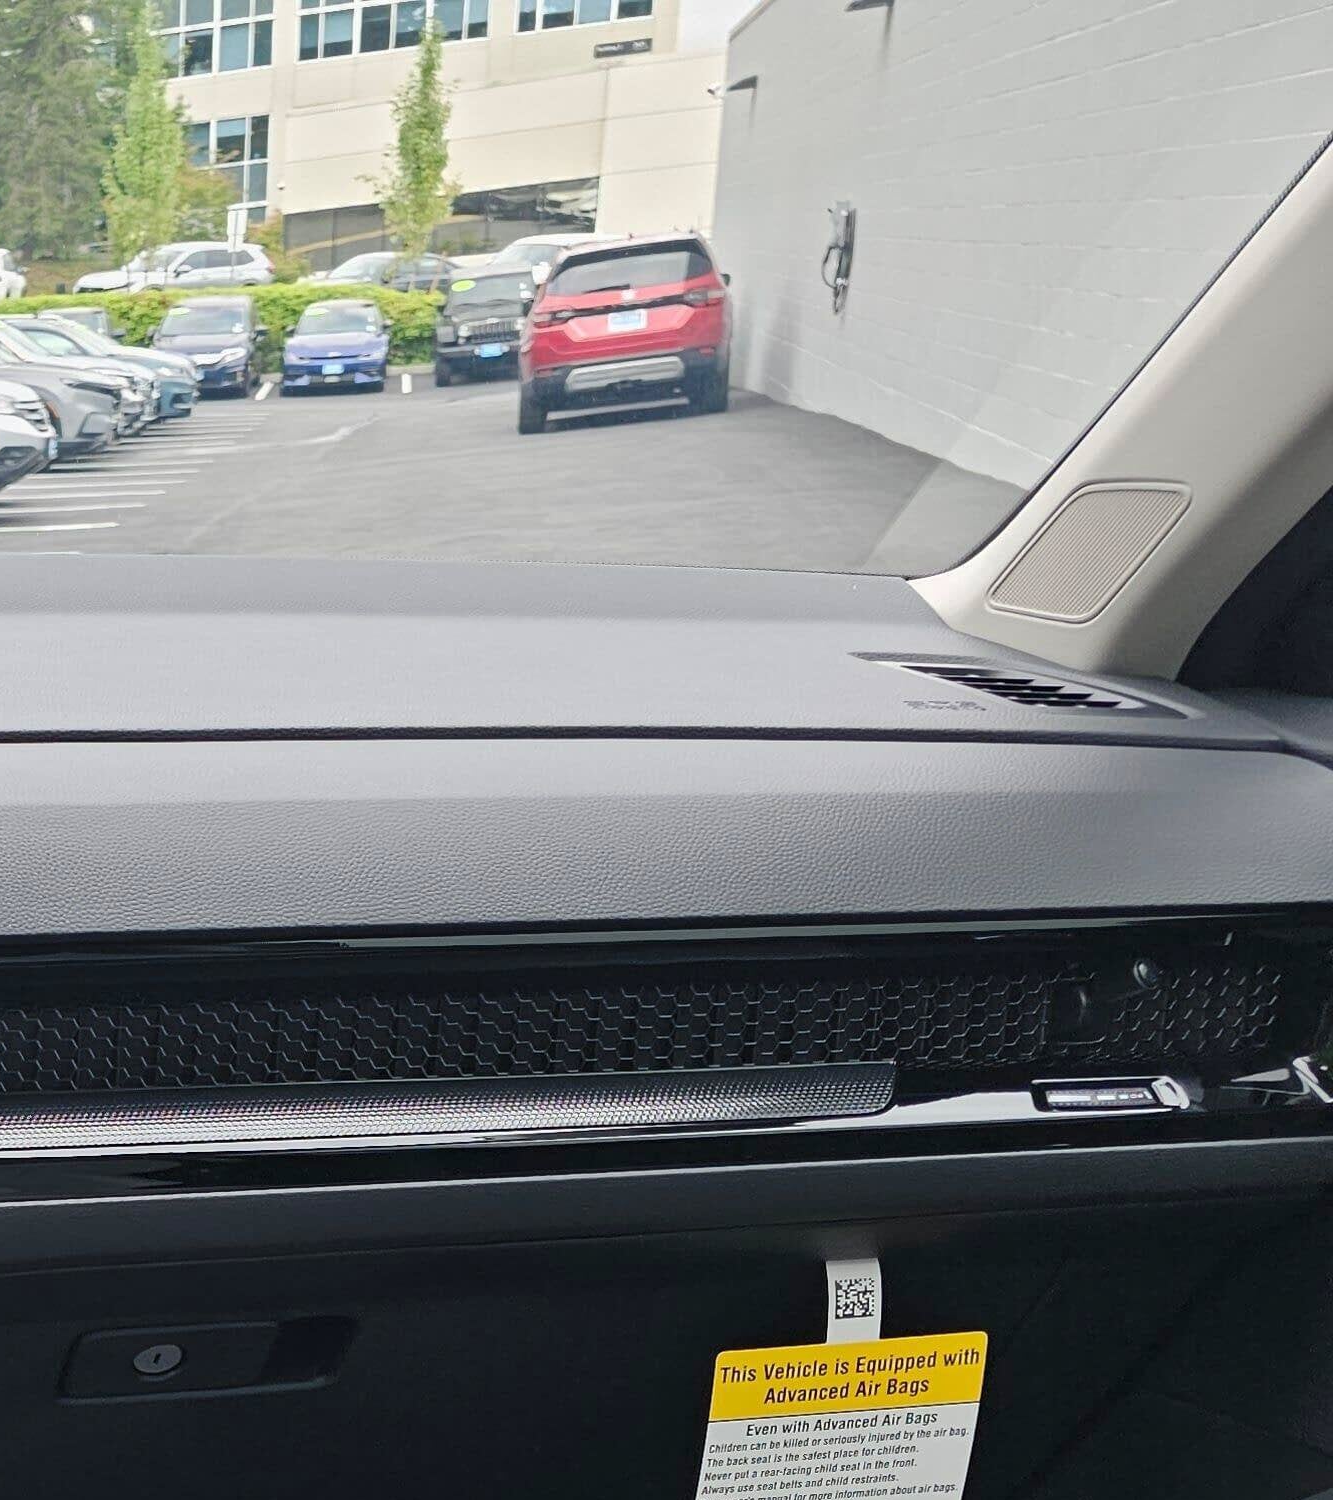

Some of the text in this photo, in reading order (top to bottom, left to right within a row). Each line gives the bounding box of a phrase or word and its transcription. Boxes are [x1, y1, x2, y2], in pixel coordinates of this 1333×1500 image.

[721, 1348, 980, 1384] This Vehicle is Equipped with
[764, 1378, 930, 1405] Advanced Air Bags
[746, 1412, 938, 1437] Even with Advanced Air Bags
[709, 1427, 970, 1454] Children can be killed or seriously injured by the air bag.
[707, 1445, 920, 1468] The back seat is the safest place for children.
[704, 1472, 733, 1482] Never
[734, 1470, 750, 1482] put
[760, 1466, 812, 1478] rear-facing
[814, 1463, 838, 1474] child
[840, 1461, 860, 1472] seat
[863, 1460, 872, 1470] in
[874, 1459, 890, 1470] the
[892, 1458, 918, 1469] front.
[701, 1473, 899, 1496] Always use seat belts and child restraints.
[808, 1491, 833, 1500] more
[835, 1487, 888, 1500] information
[889, 1485, 917, 1496] about
[918, 1484, 932, 1494] air
[933, 1483, 959, 1493] bags.
